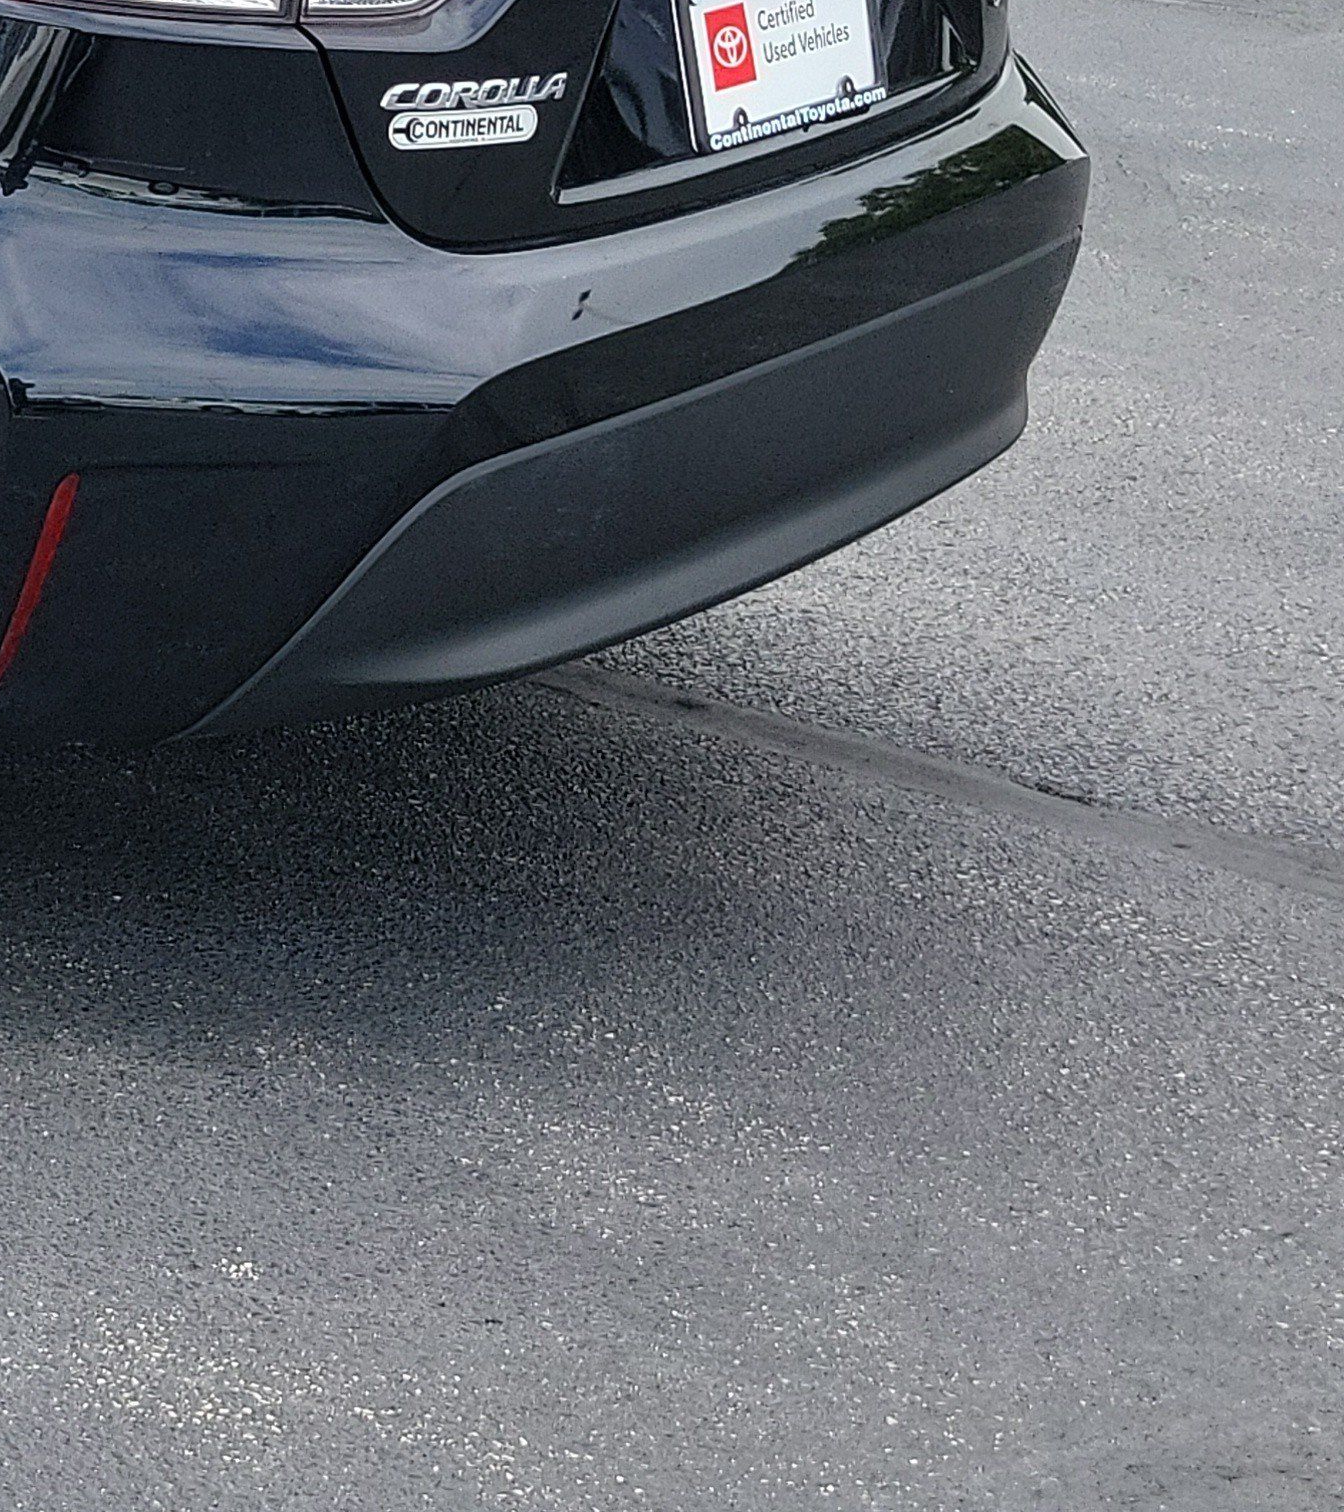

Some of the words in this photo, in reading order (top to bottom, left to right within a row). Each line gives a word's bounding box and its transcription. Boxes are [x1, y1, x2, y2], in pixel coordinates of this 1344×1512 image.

[763, 36, 797, 64] Used
[798, 22, 850, 52] Vehicles
[379, 72, 568, 111] COROLLA
[411, 114, 524, 141] CONTINENTAL
[710, 86, 887, 151] ContinentalToyota.com
